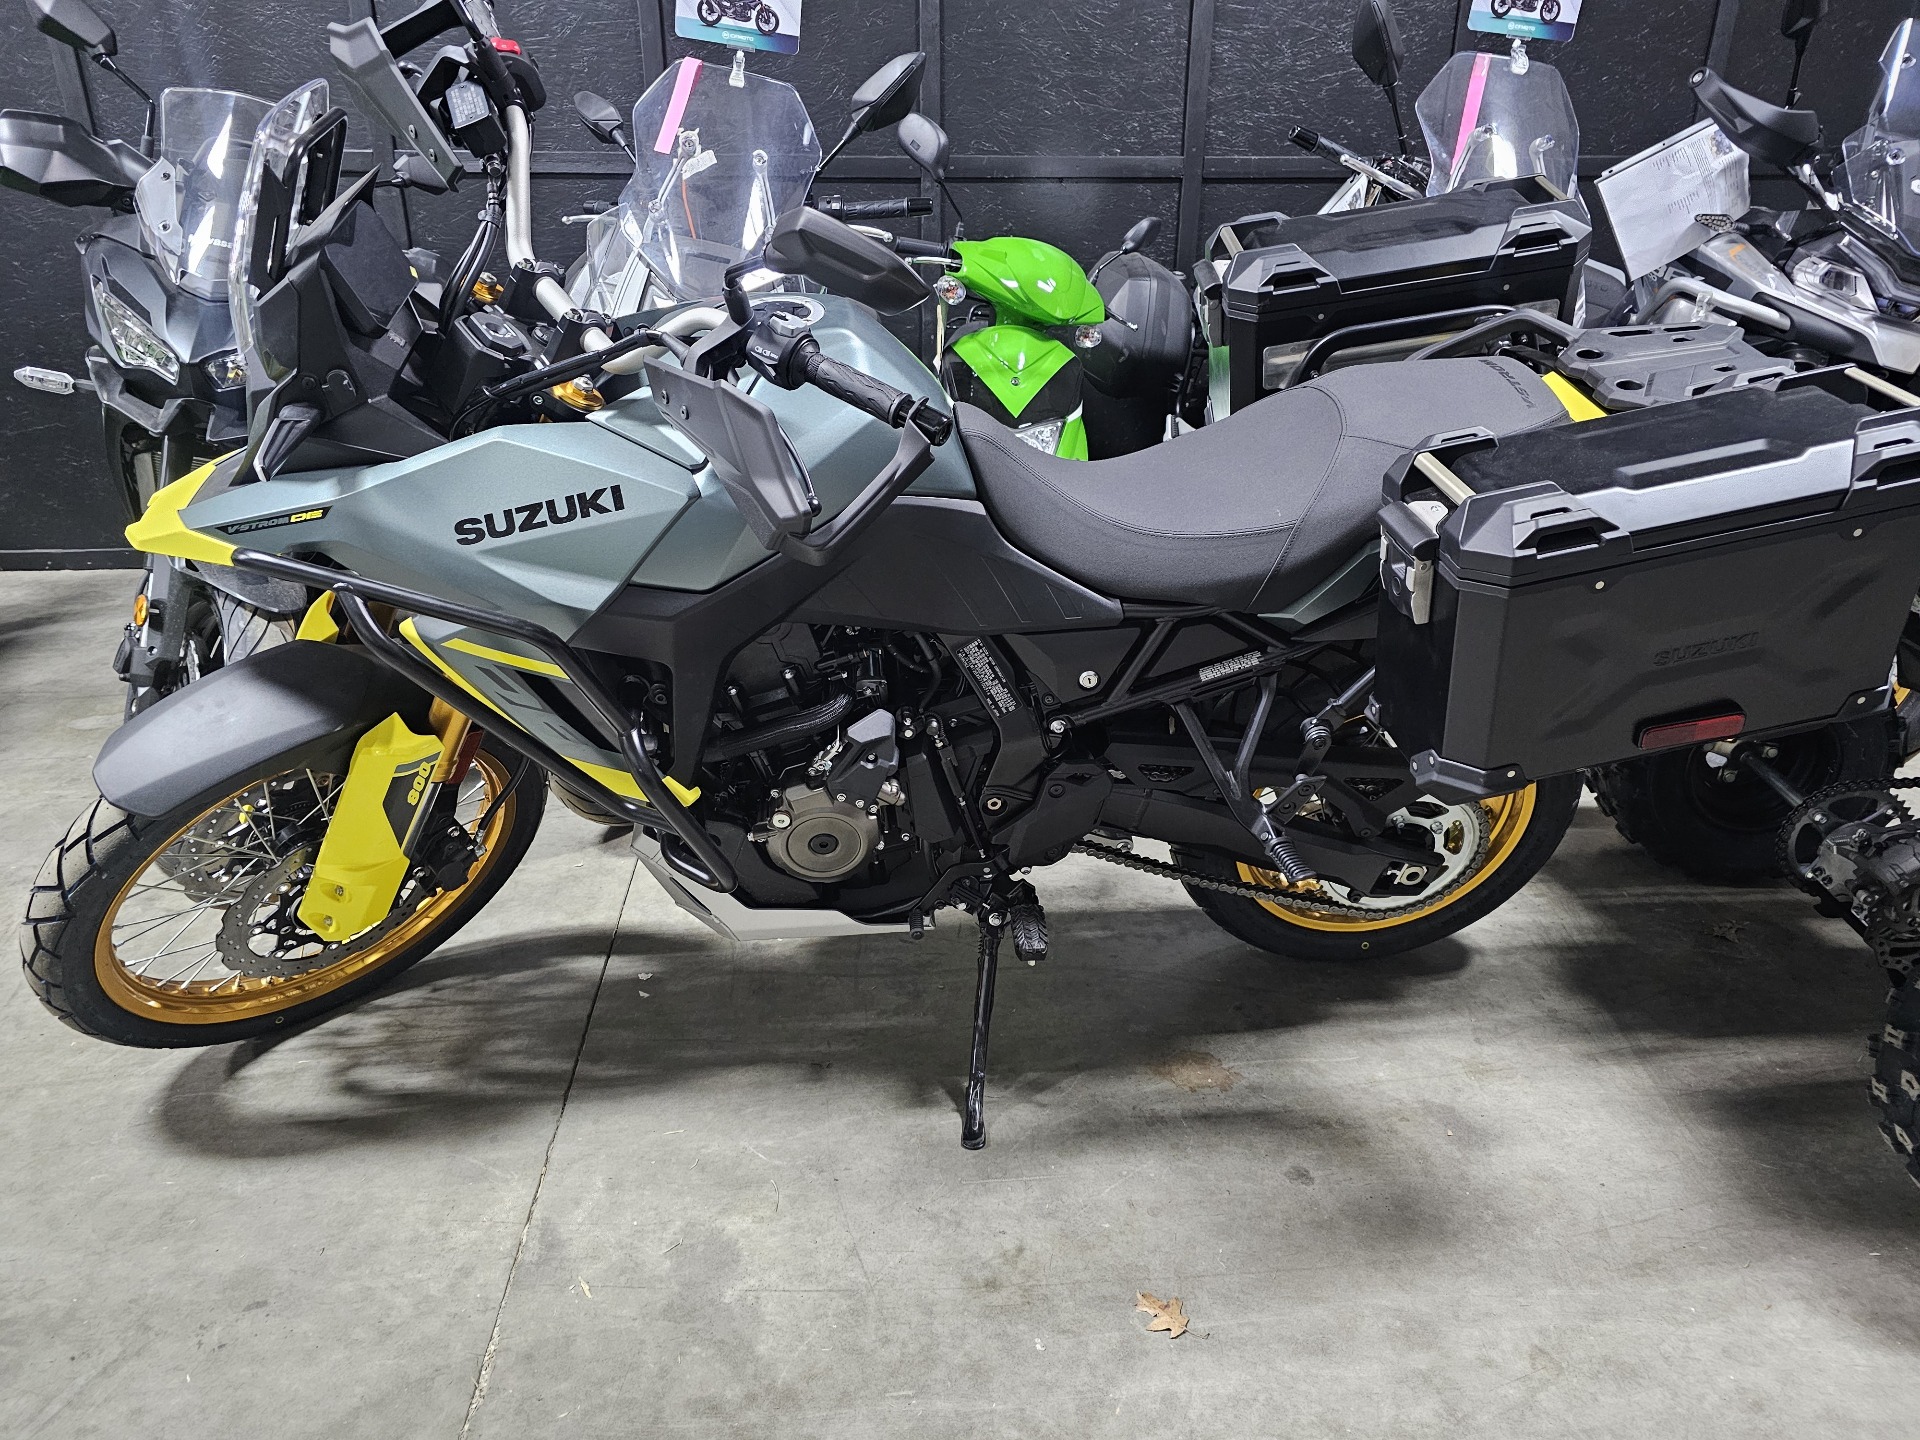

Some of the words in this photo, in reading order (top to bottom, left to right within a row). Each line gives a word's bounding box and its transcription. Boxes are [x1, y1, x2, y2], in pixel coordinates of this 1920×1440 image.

[227, 516, 289, 534] V-STROM
[290, 509, 324, 523] DE
[454, 484, 625, 546] SUZUKI
[1653, 631, 1760, 667] SUZUKI
[407, 761, 430, 806] 800
